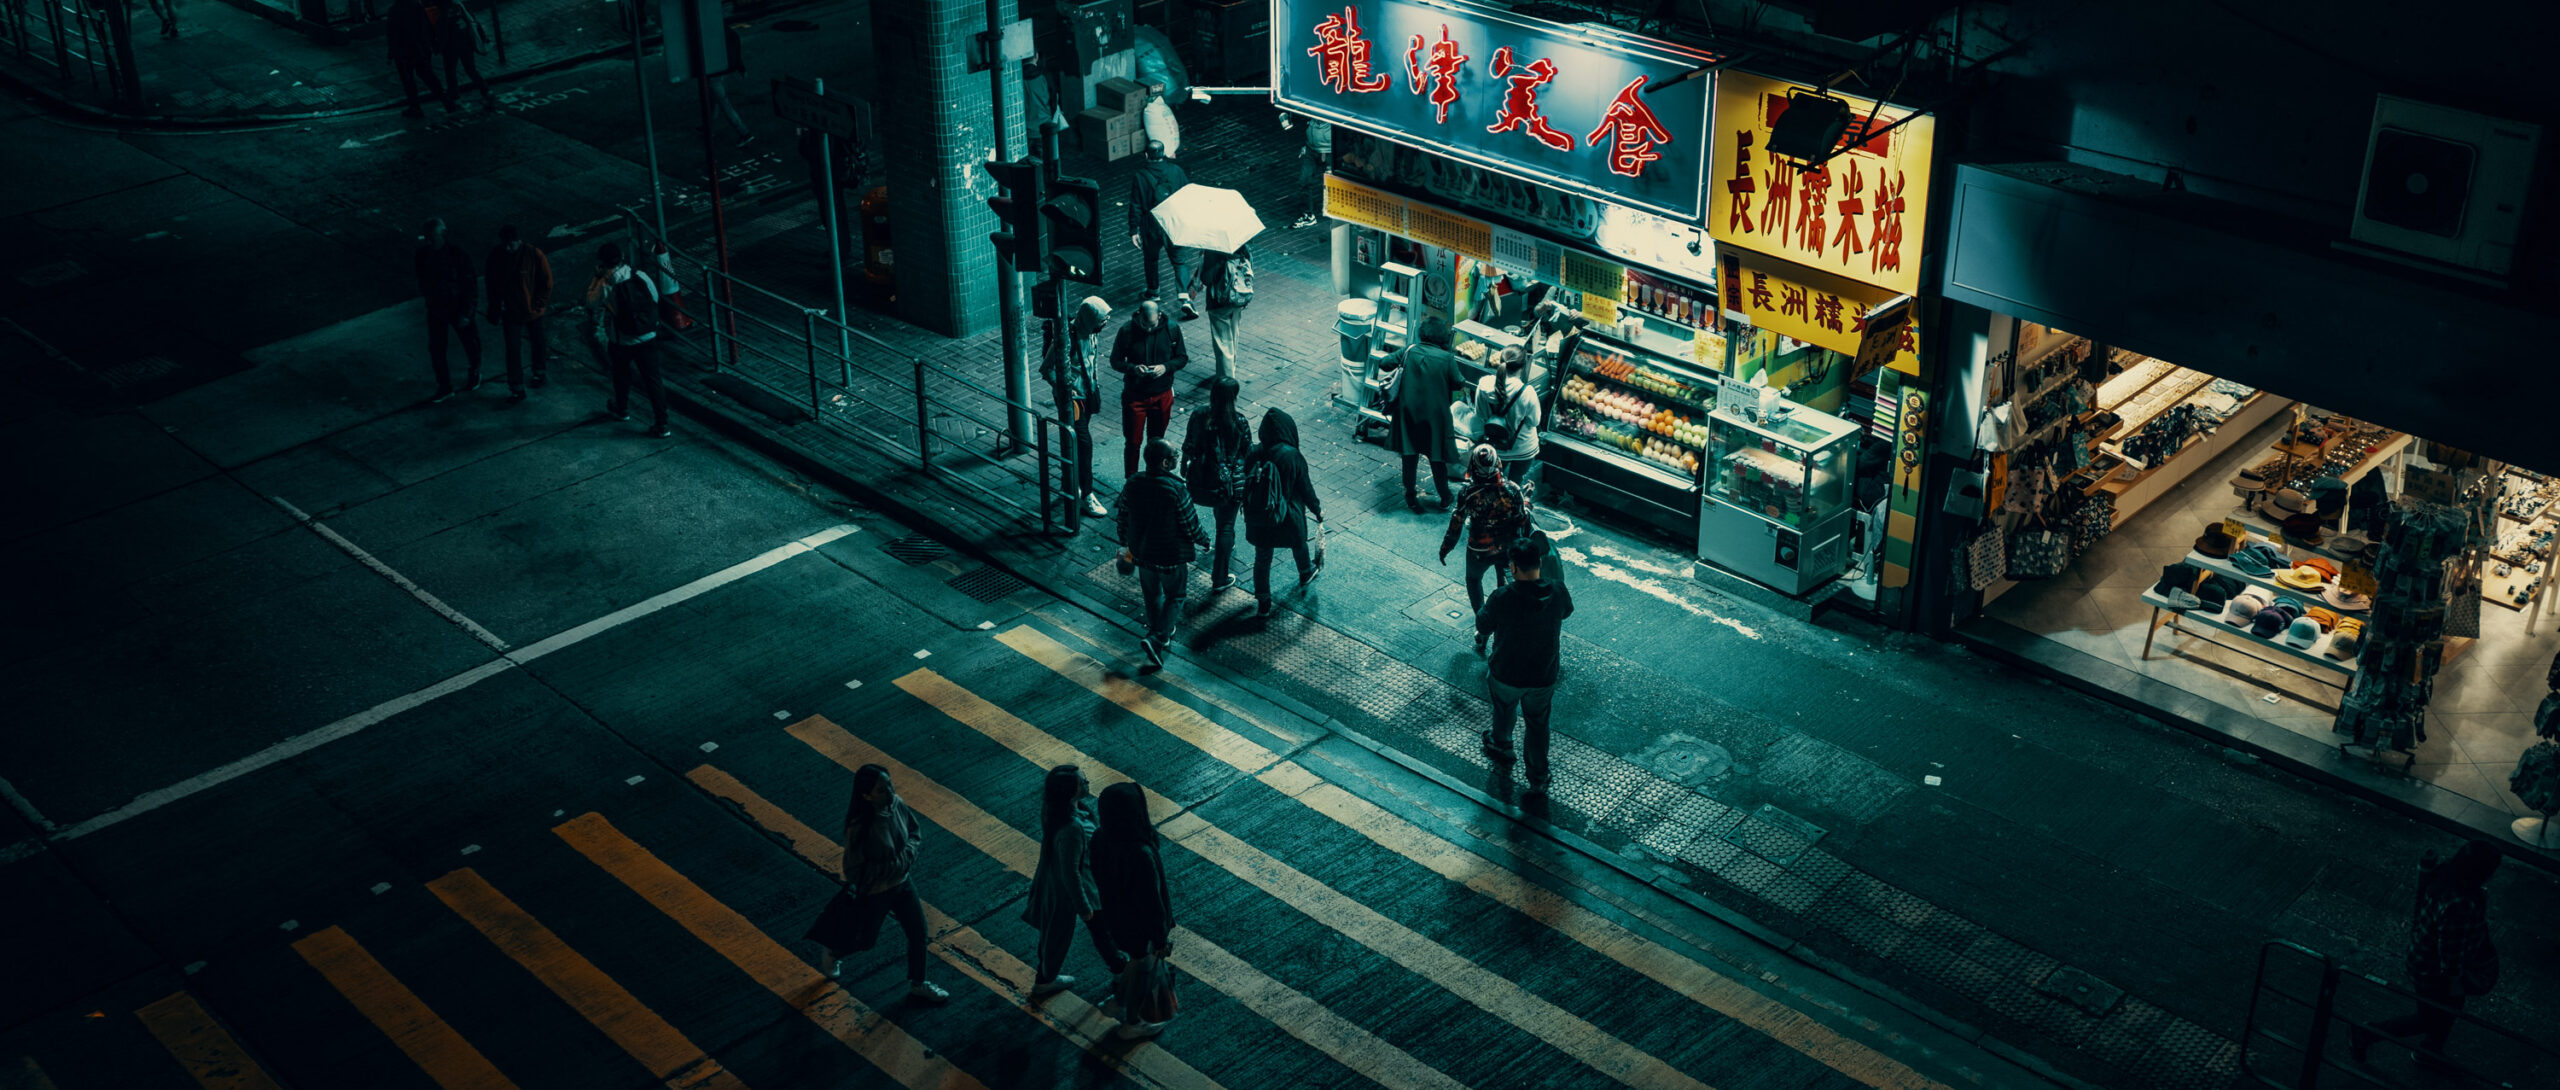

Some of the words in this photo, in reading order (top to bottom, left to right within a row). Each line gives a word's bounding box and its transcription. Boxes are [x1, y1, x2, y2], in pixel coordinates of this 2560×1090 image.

[508, 87, 590, 112] LOOK
[1308, 5, 1673, 178] 龍津美食
